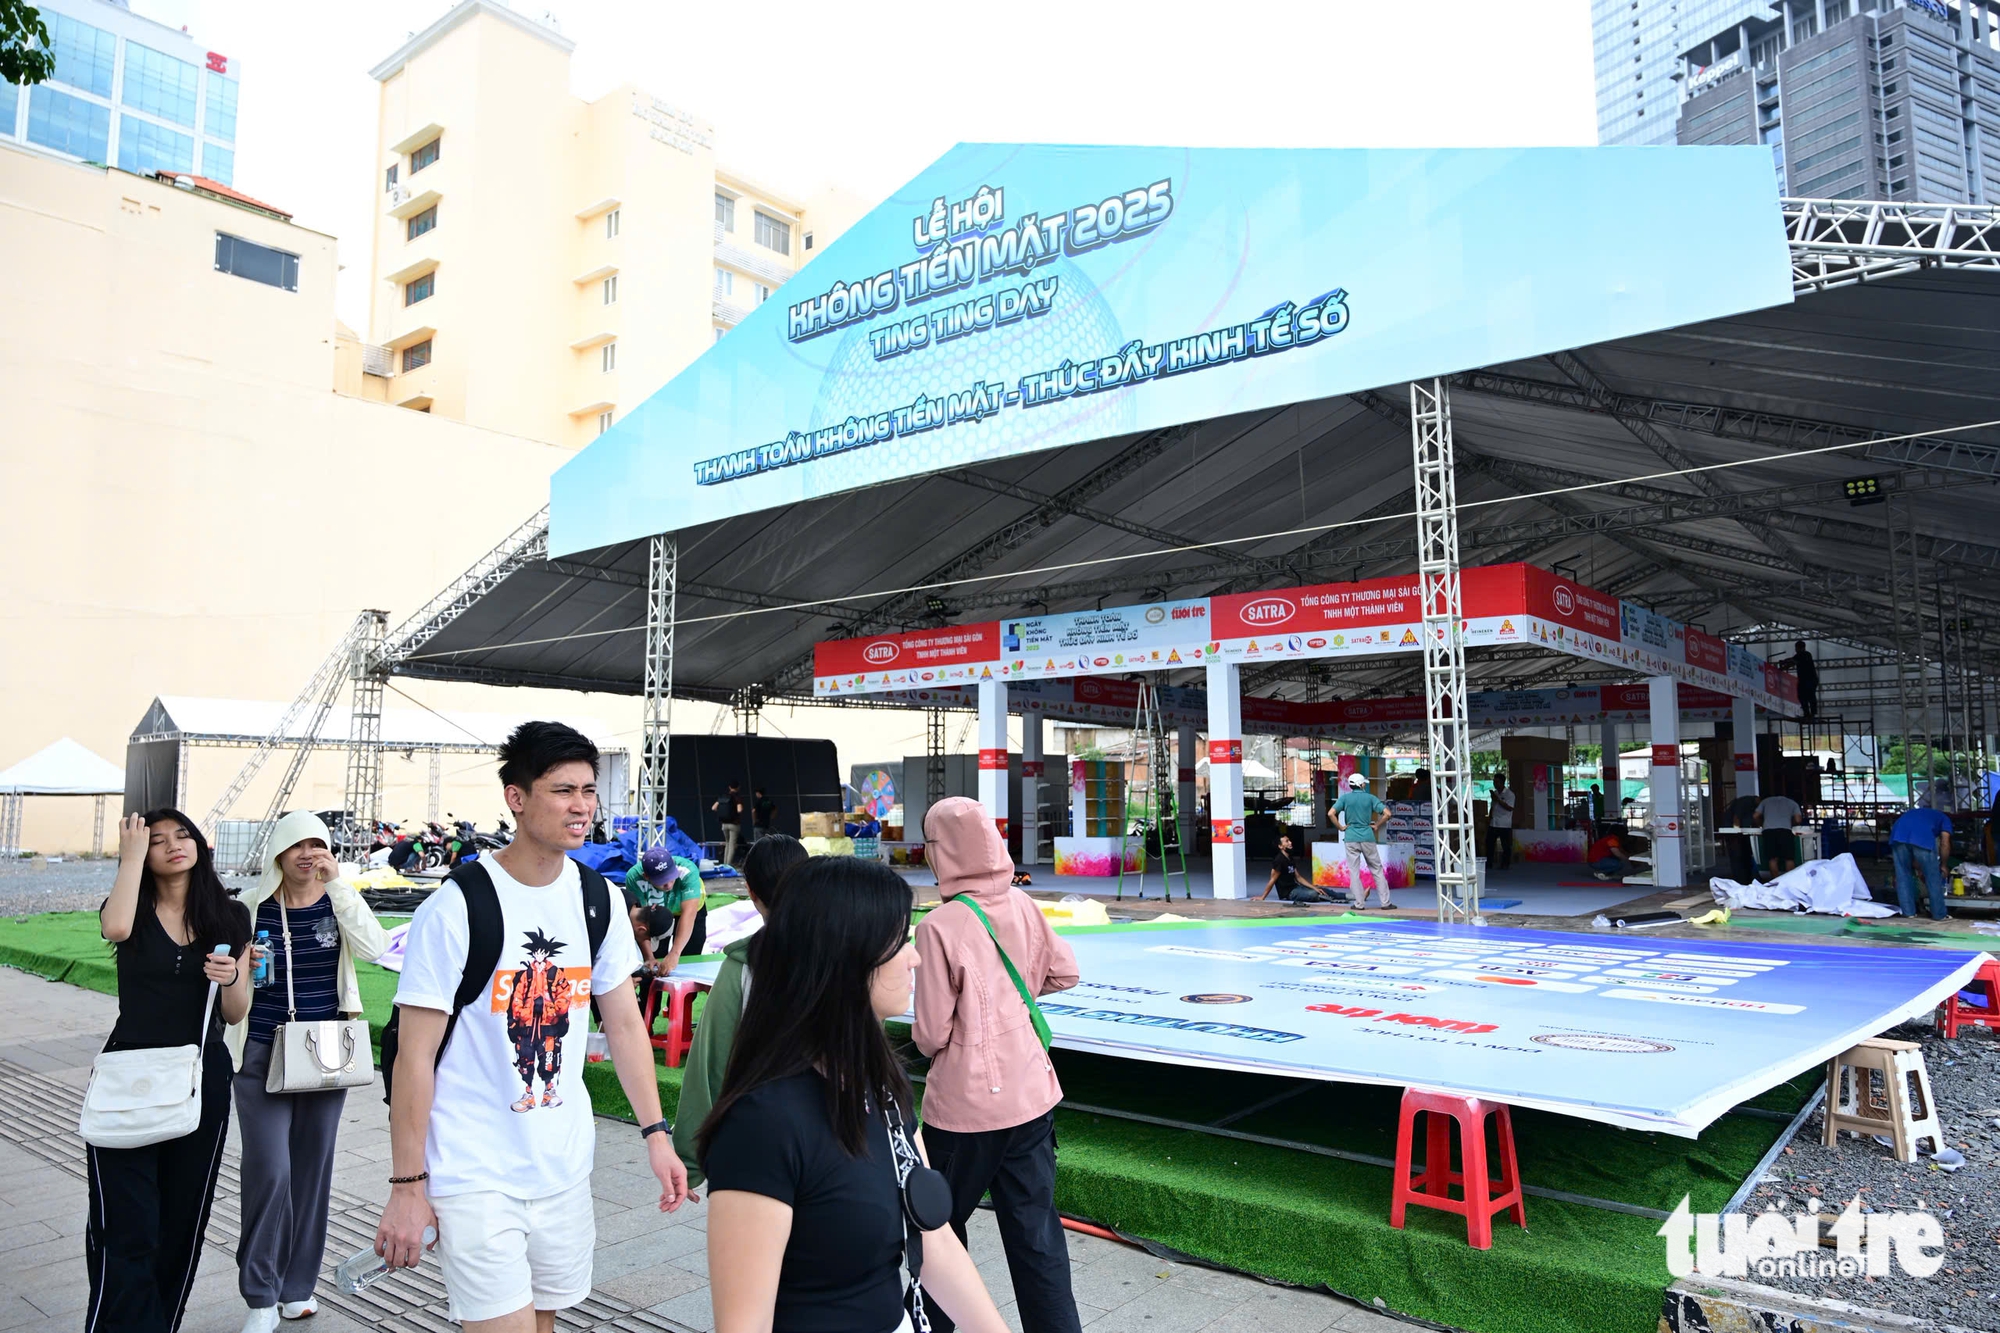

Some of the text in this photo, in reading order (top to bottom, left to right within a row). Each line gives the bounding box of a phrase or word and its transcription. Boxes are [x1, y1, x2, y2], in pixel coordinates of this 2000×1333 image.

[1687, 53, 1739, 90] Keppel
[913, 184, 1004, 247] LỄ HỘI
[788, 177, 1174, 341] KHÔNG TIỀN MẶT 2025
[869, 275, 1059, 361] TING TING DAY
[694, 448, 758, 485] THANH
[758, 431, 813, 470] TOÁN
[814, 411, 892, 457] KHÔNG
[892, 392, 945, 438] TIỀN
[946, 380, 1005, 425] MẶT
[1022, 358, 1097, 406] THÚC
[1098, 339, 1166, 389] ĐẨY
[1166, 322, 1248, 373] KINH
[1249, 299, 1298, 355] TẾ
[1296, 287, 1350, 346] SỐ
[1300, 586, 1422, 607] TỔNG CÔNG TY THƯƠNG MẠI SÀI GÒ
[1248, 603, 1286, 620] SATRA
[1323, 602, 1404, 619] TNHH MỘT THÀNH VIÊN
[868, 645, 894, 660] SATRA
[1303, 961, 1379, 971] VISA
[1073, 1010, 1190, 1029] TING
[1180, 1021, 1307, 1044] KHU
